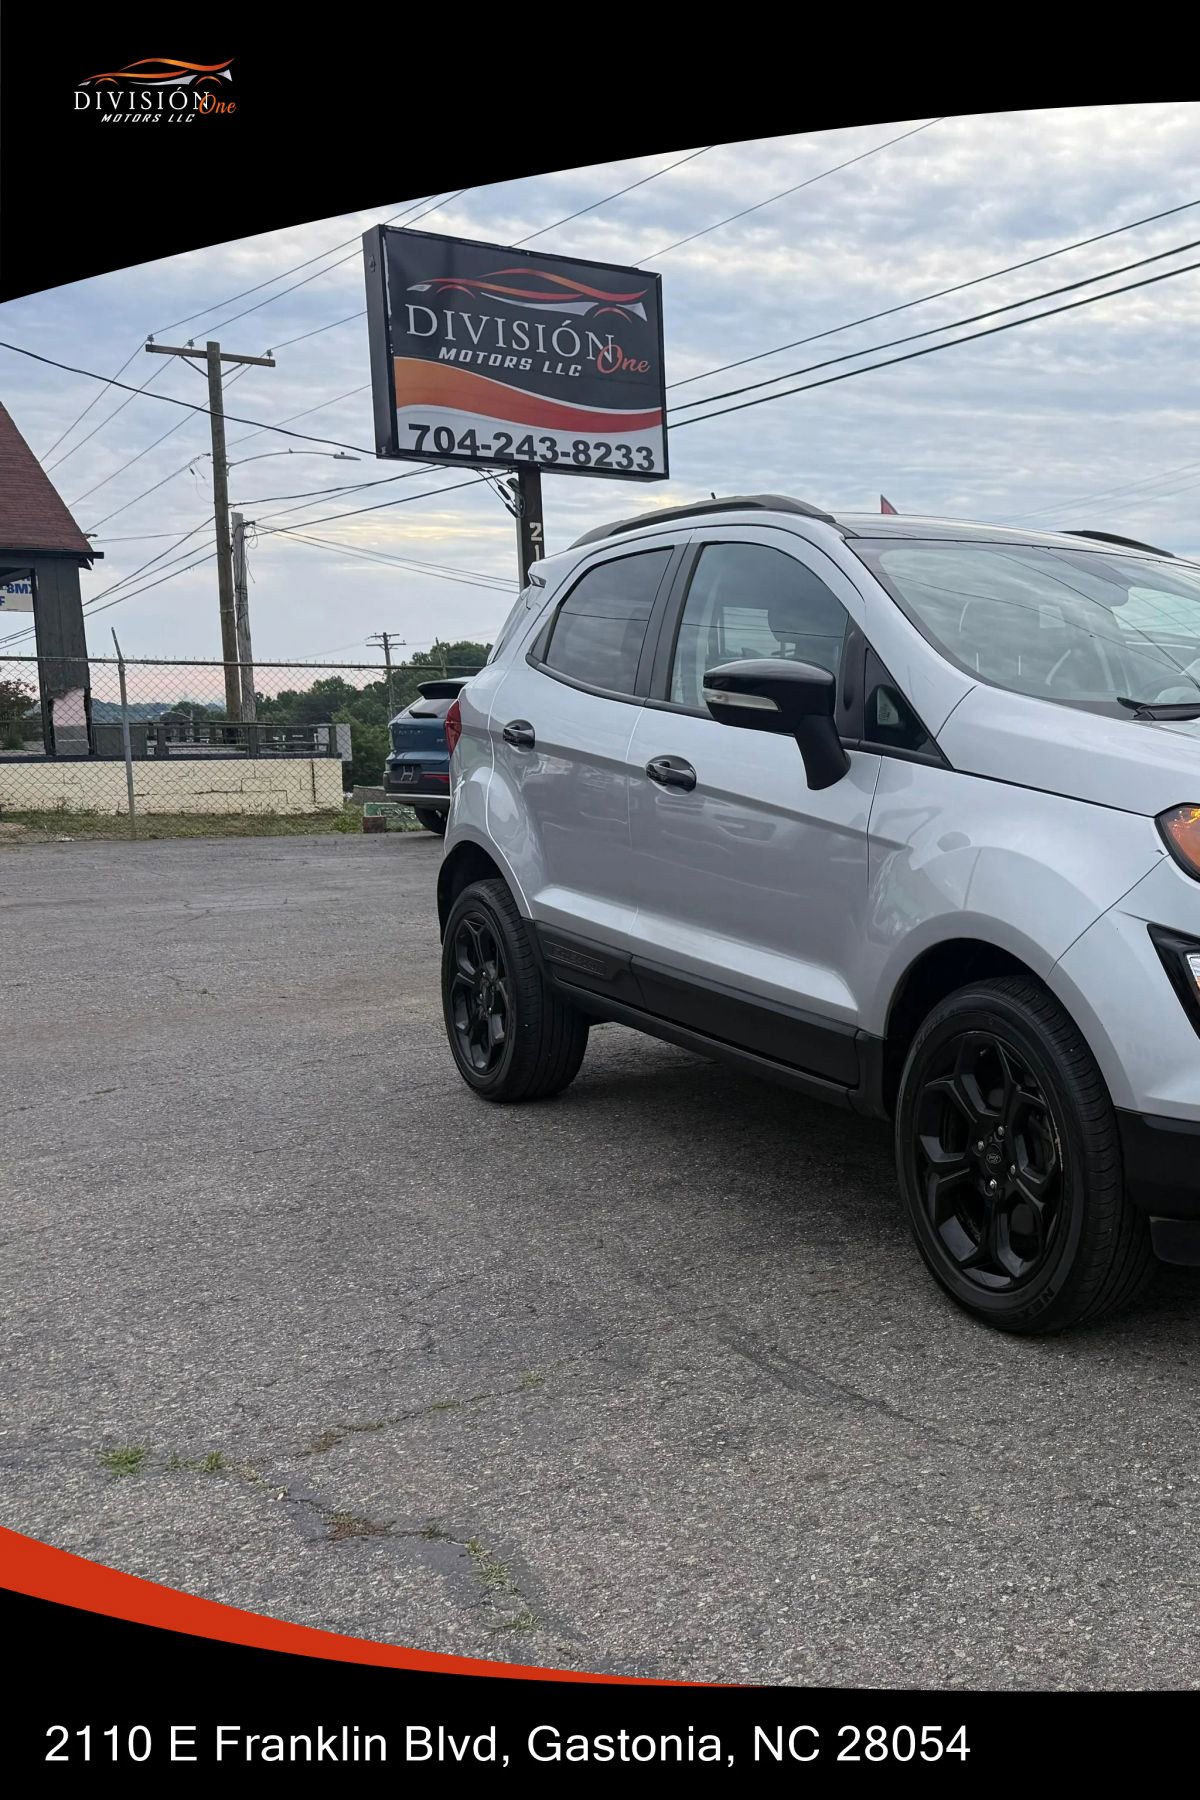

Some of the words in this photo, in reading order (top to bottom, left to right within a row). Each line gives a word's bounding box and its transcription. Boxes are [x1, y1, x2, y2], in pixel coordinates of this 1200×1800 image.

[405, 303, 614, 363] DIVISIÓN
[597, 345, 650, 373] One
[438, 347, 532, 370] MOTORS
[542, 360, 582, 377] LLC
[408, 424, 655, 471] 704-243-8233
